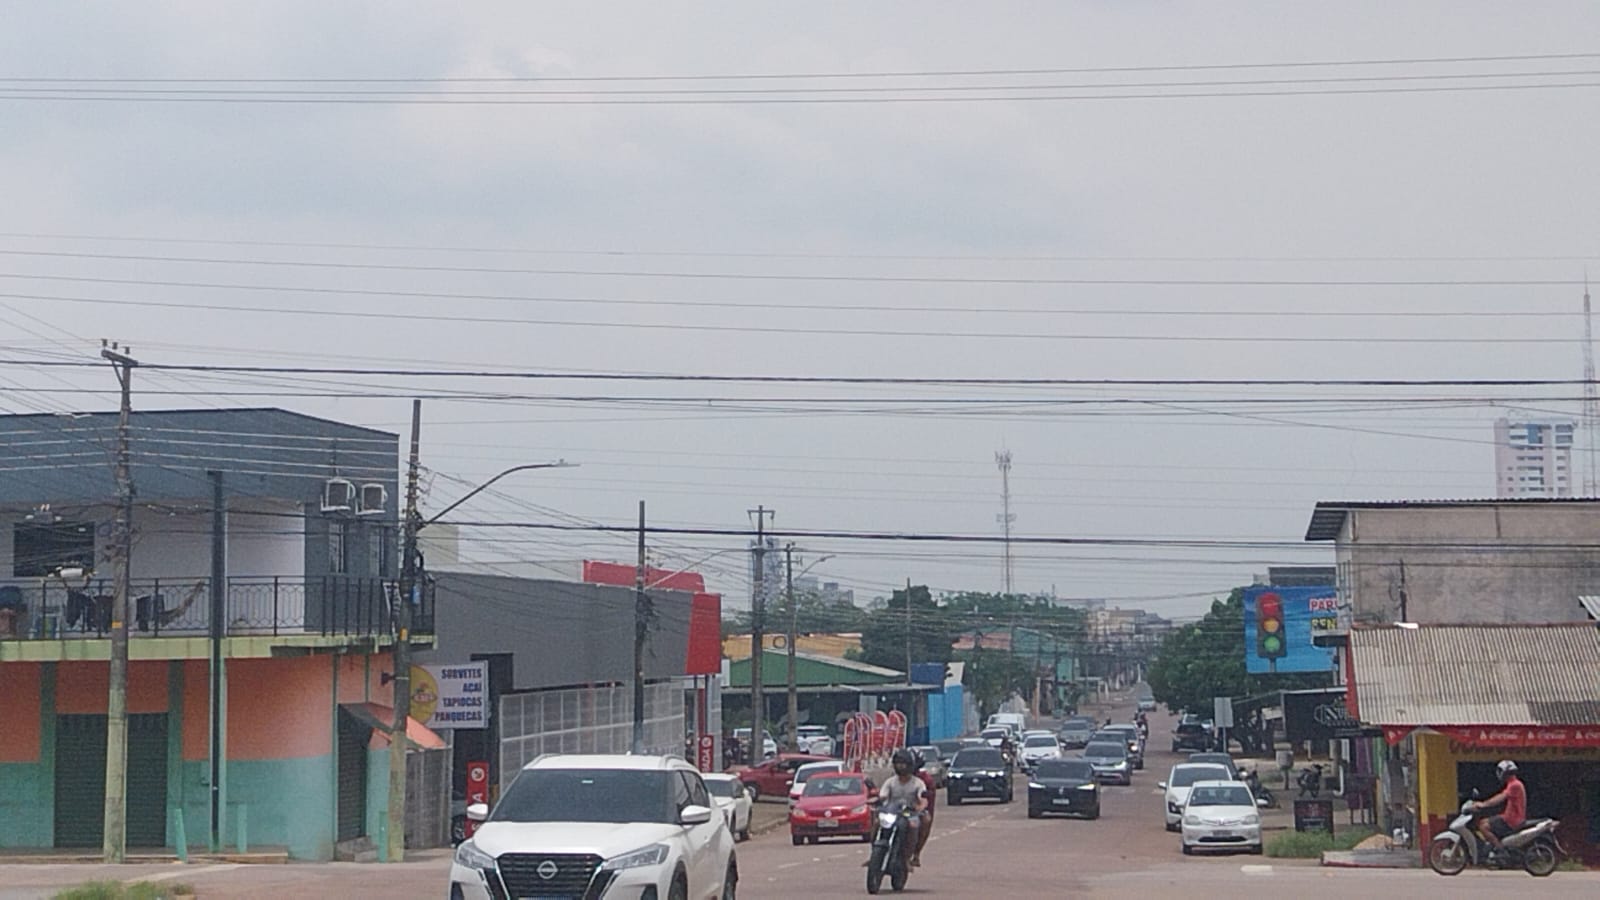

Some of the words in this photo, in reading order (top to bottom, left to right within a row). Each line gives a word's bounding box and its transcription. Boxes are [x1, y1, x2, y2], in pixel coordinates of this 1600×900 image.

[441, 668, 482, 679] SORVETES
[443, 697, 482, 708] TAPIOCAS
[435, 711, 482, 722] PANQUECAS
